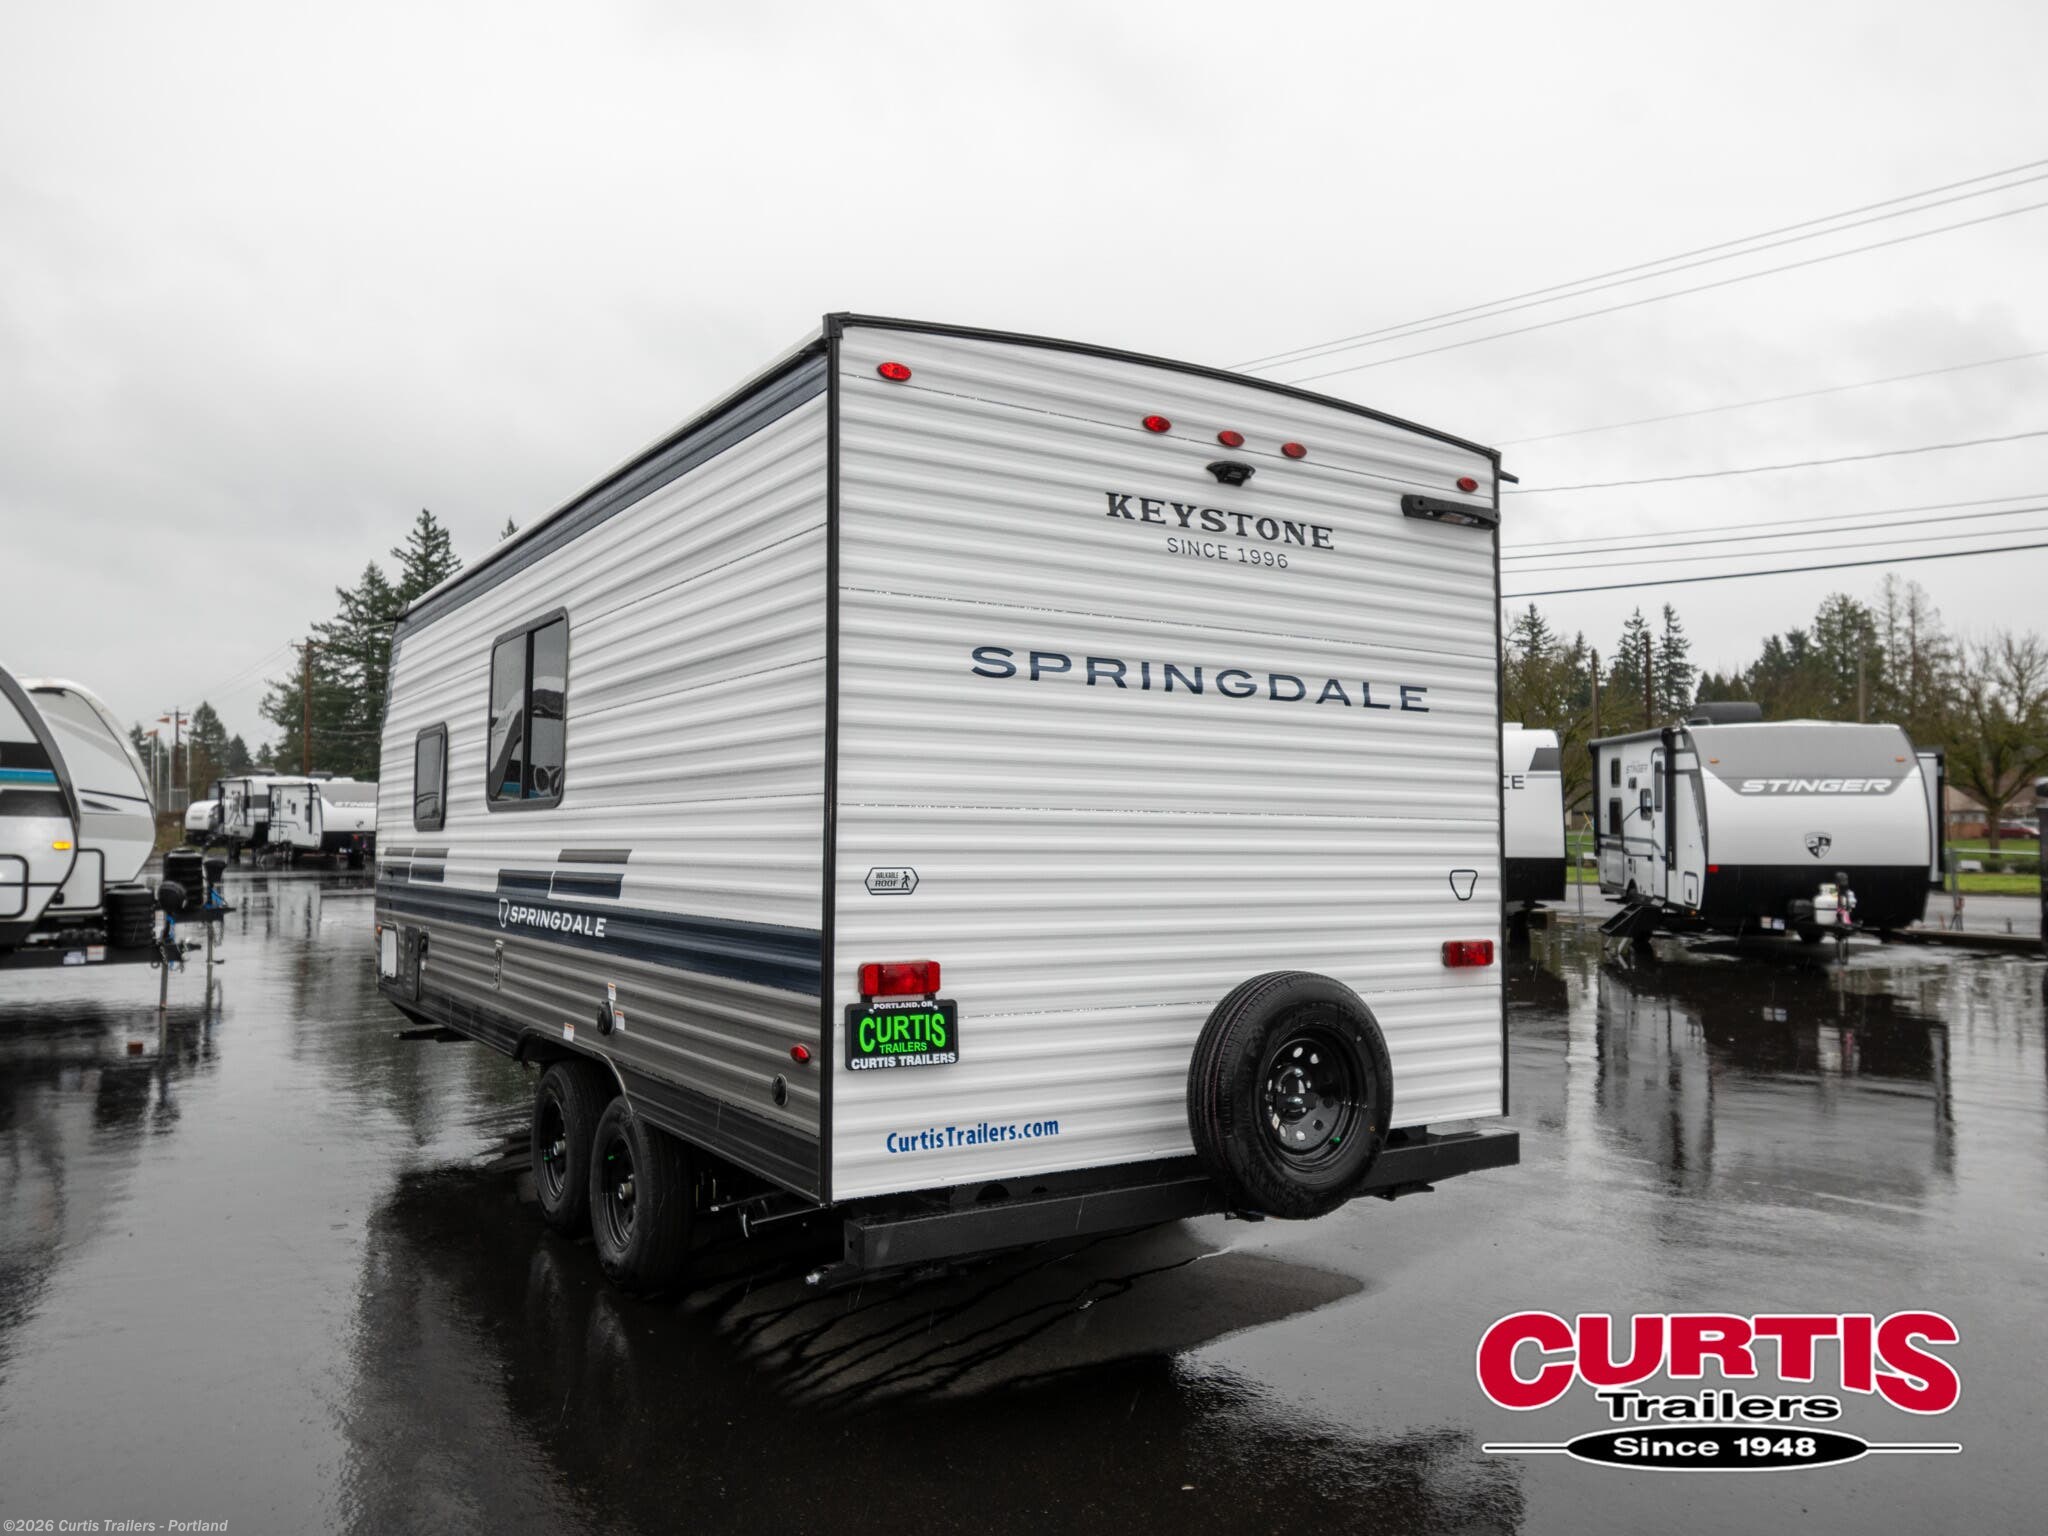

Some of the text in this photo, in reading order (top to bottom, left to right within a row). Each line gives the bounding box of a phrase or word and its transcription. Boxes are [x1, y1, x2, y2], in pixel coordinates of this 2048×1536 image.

[1105, 491, 1335, 550] KEYSTONE
[1167, 537, 1289, 569] SINCE 1996
[971, 645, 1430, 713] SPRINGDALE
[1740, 778, 1892, 793] STINGER
[875, 879, 898, 887] ROOF
[509, 905, 607, 938] SPRINGDALE
[873, 1001, 920, 1010] PORTLAND,
[859, 1013, 946, 1053] CURTIS
[879, 1041, 928, 1054] TRAILERS
[851, 1052, 956, 1070] CURTIS TRAILERS
[886, 1120, 1059, 1153] CurtisTrailers.com
